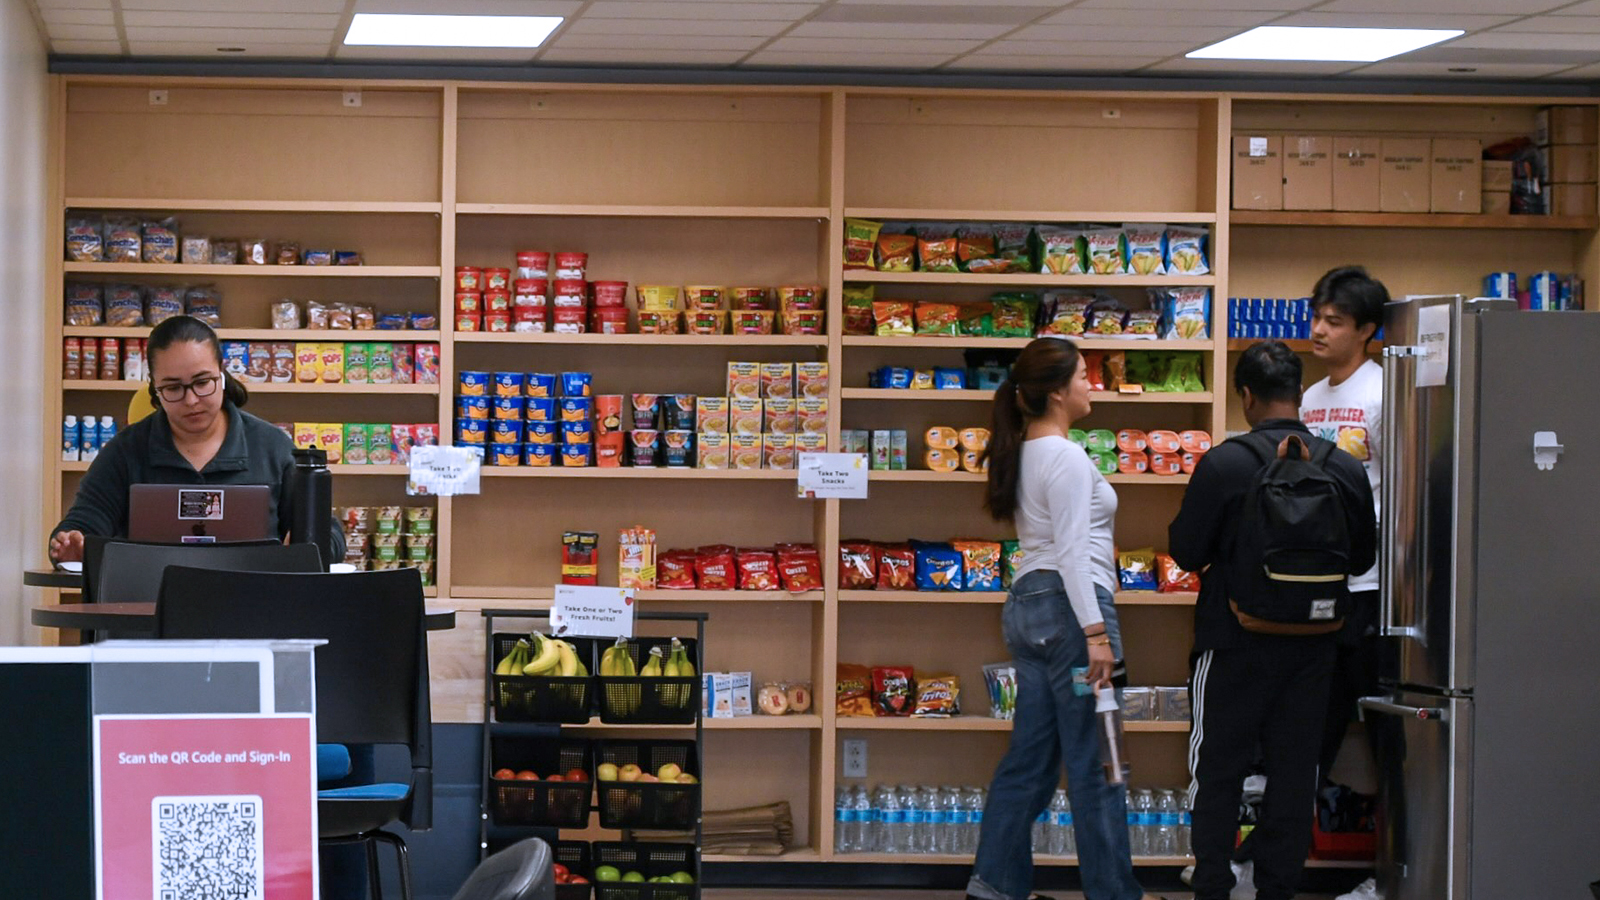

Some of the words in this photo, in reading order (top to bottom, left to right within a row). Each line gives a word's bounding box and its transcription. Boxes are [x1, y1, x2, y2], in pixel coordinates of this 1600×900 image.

[592, 614, 616, 622] Fruits!
[118, 752, 146, 764] Scan
[149, 752, 168, 764] the
[171, 752, 189, 765] QR
[191, 751, 221, 763] Code
[224, 751, 246, 763] and
[249, 751, 291, 766] Sign-In
